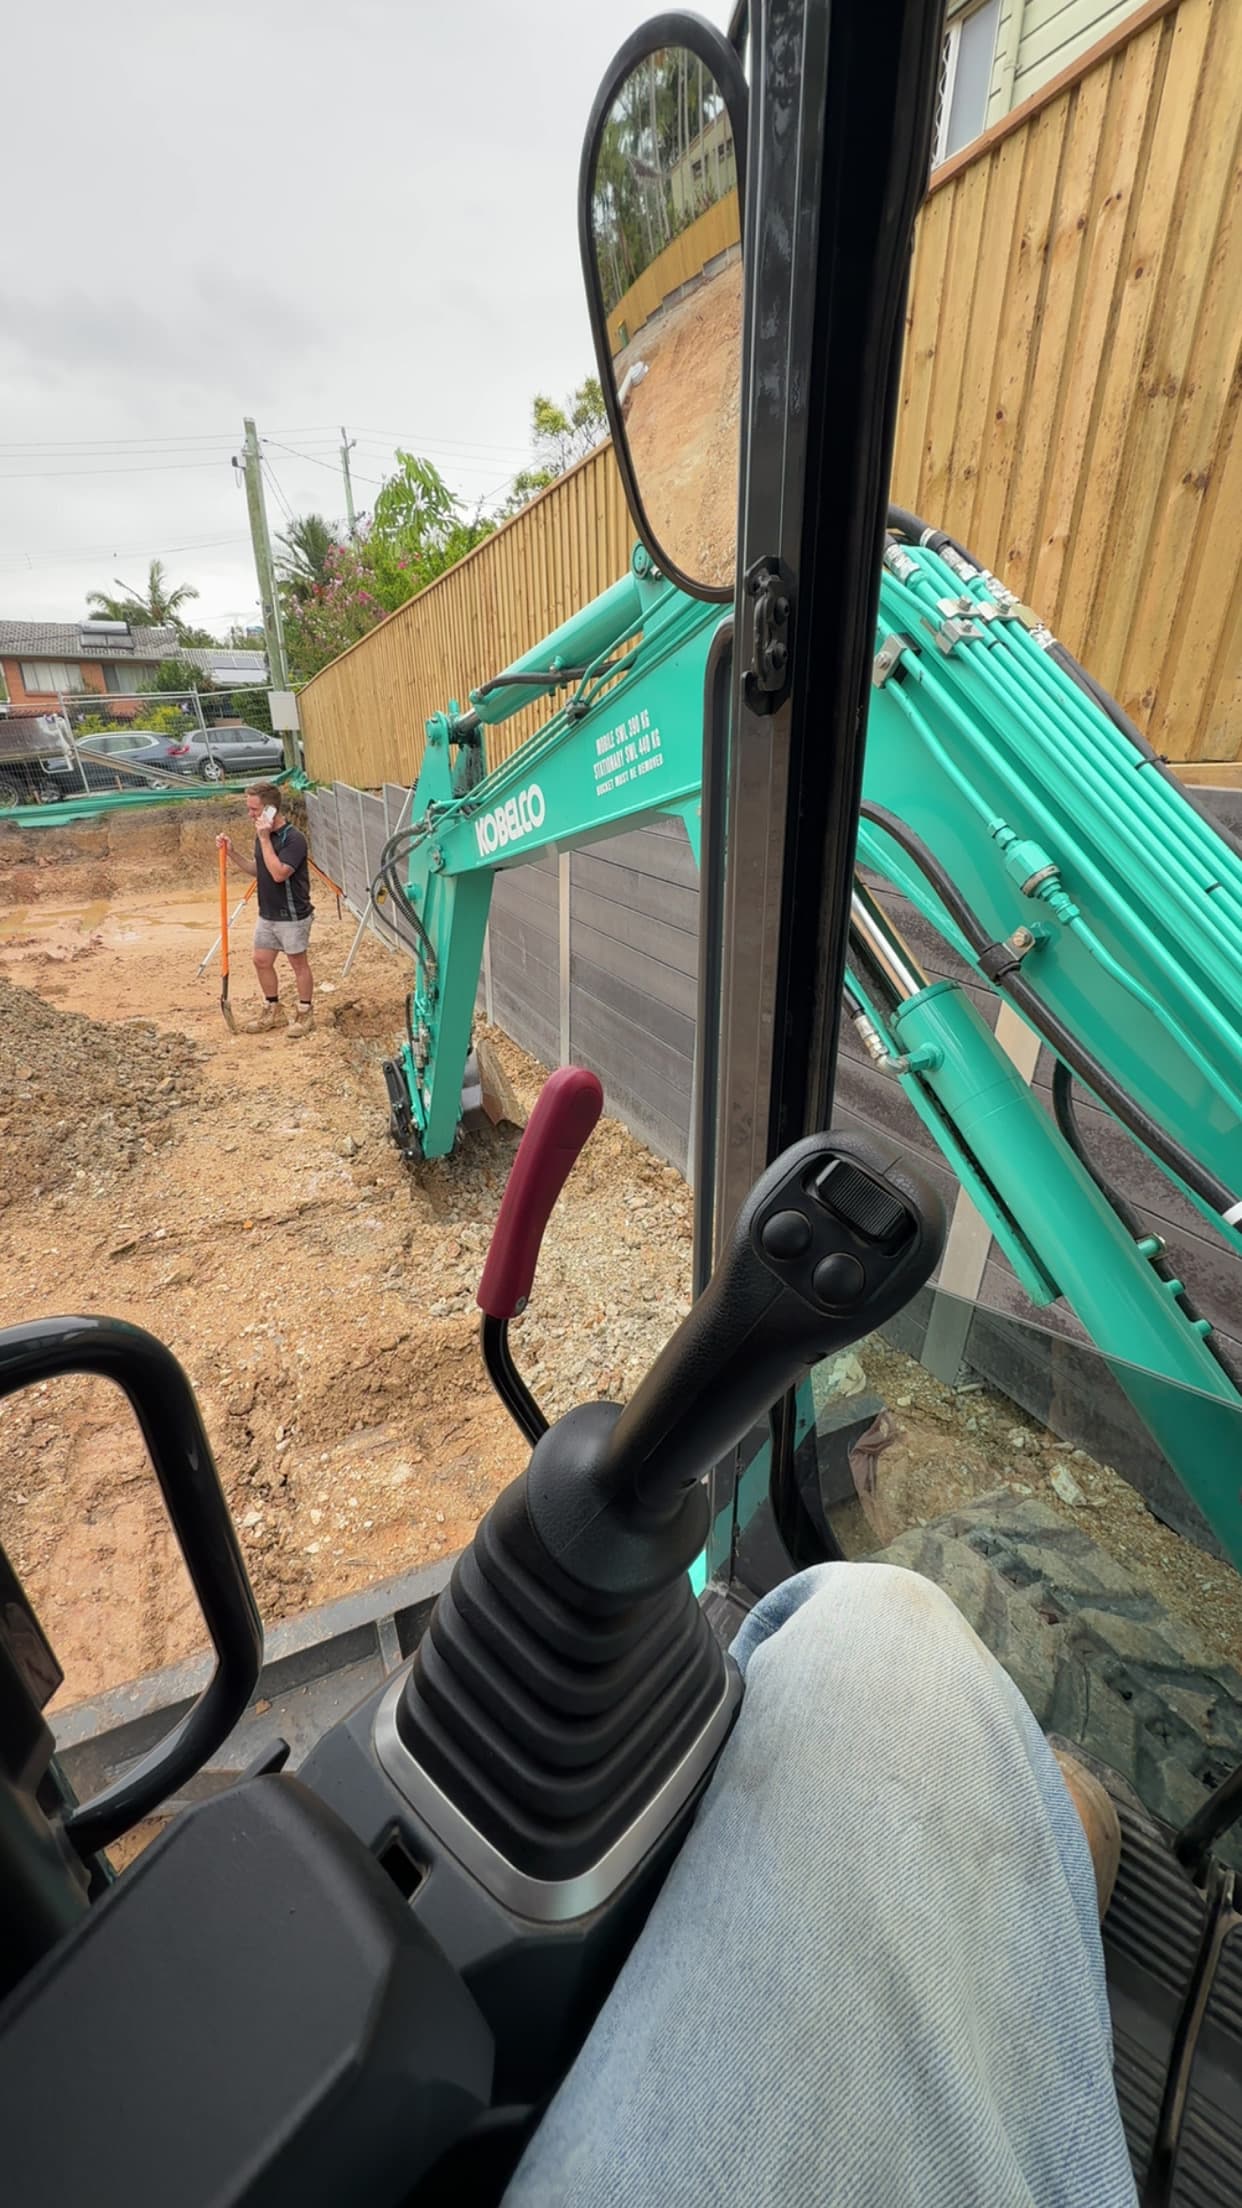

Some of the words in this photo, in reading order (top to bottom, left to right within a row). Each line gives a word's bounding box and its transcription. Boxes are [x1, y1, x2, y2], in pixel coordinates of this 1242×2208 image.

[615, 723, 628, 745] SWL
[640, 708, 650, 729] KG
[624, 742, 638, 763] SWL
[651, 728, 661, 749] KG
[637, 753, 663, 775] REMOVED
[474, 783, 546, 856] KOBELCO
